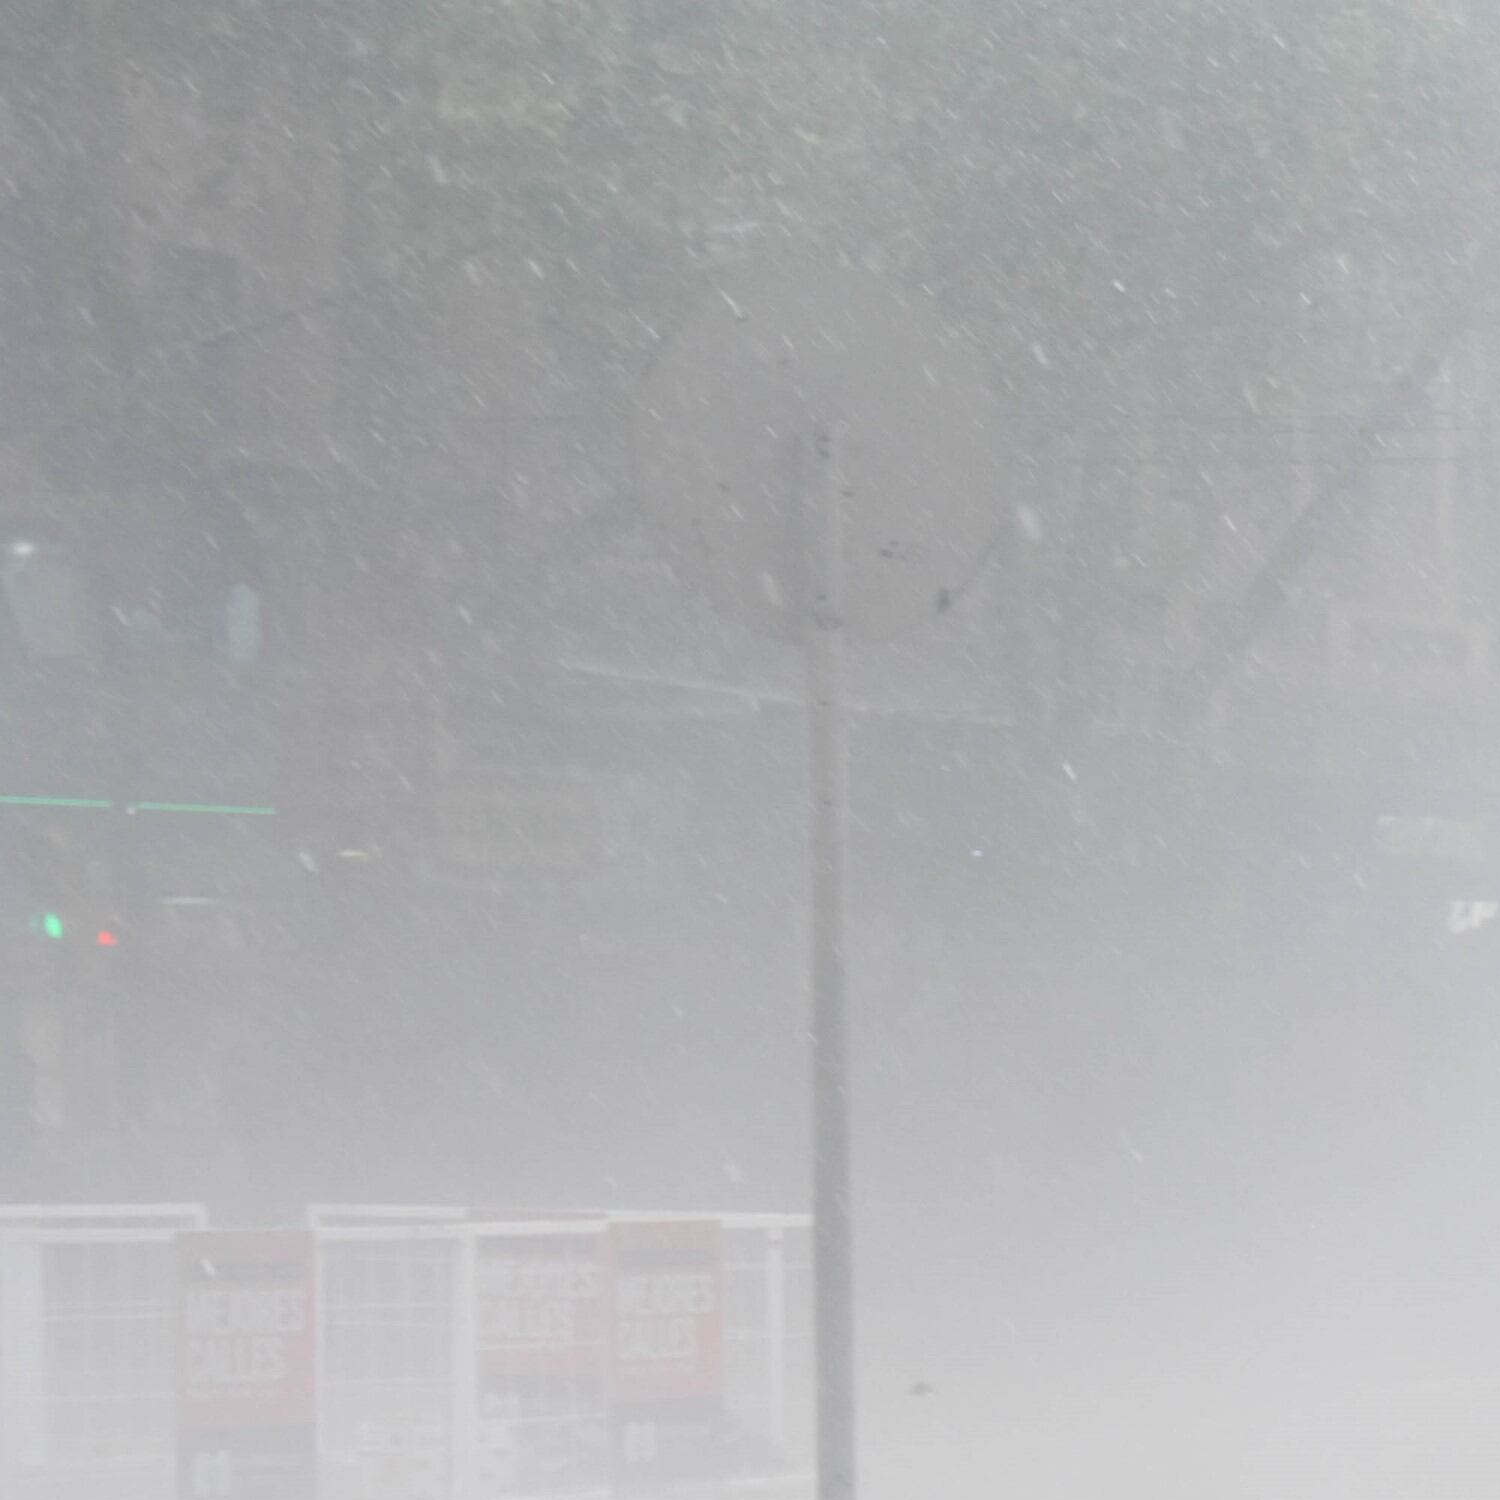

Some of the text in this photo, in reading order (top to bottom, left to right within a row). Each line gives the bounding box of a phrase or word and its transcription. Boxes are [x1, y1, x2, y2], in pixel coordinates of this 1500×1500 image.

[185, 1289, 306, 1334] MEJORES
[615, 1273, 716, 1315] MEJORES
[187, 1336, 288, 1382] CALLES
[616, 1316, 699, 1361] CALLES
